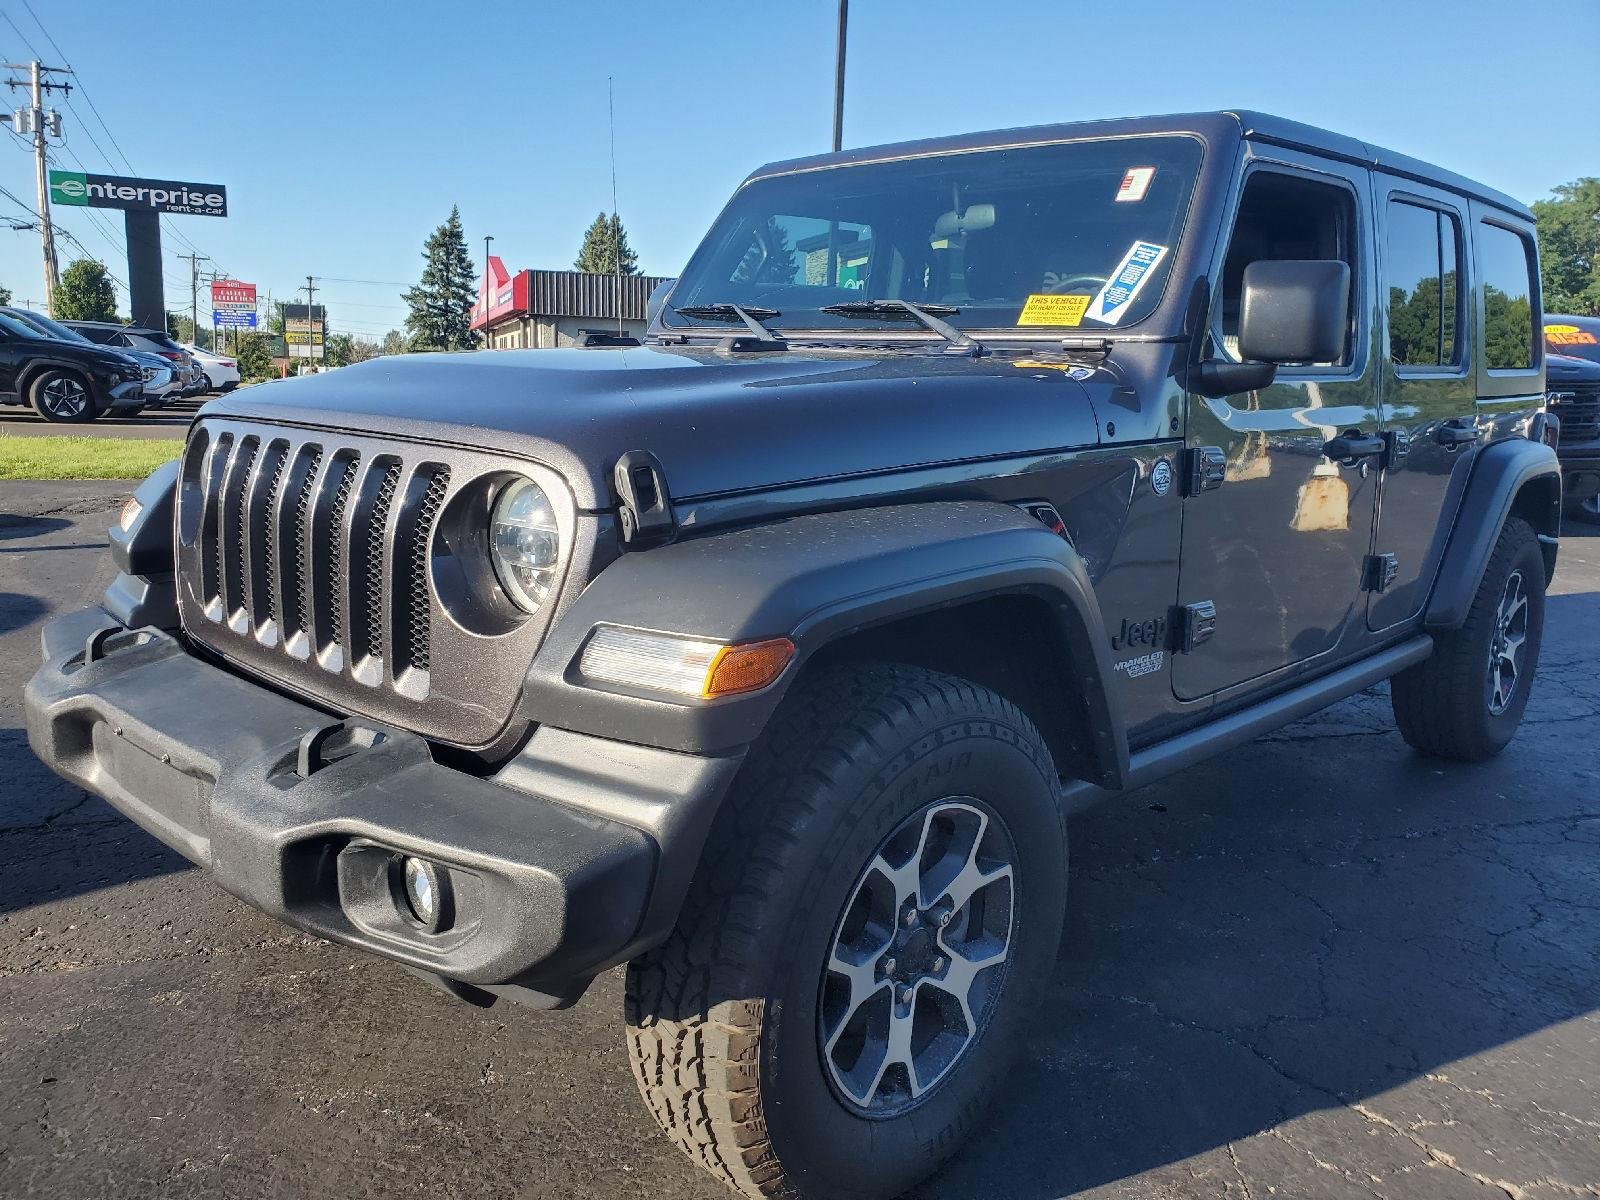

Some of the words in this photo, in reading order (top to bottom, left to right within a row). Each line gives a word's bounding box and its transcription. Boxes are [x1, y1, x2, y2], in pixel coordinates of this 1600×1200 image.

[59, 180, 224, 207] enterprise
[166, 205, 224, 215] rent-a-car
[1050, 297, 1085, 305] VEHICLE
[1112, 617, 1165, 651] Jeep
[1113, 651, 1164, 671] WRANGLER
